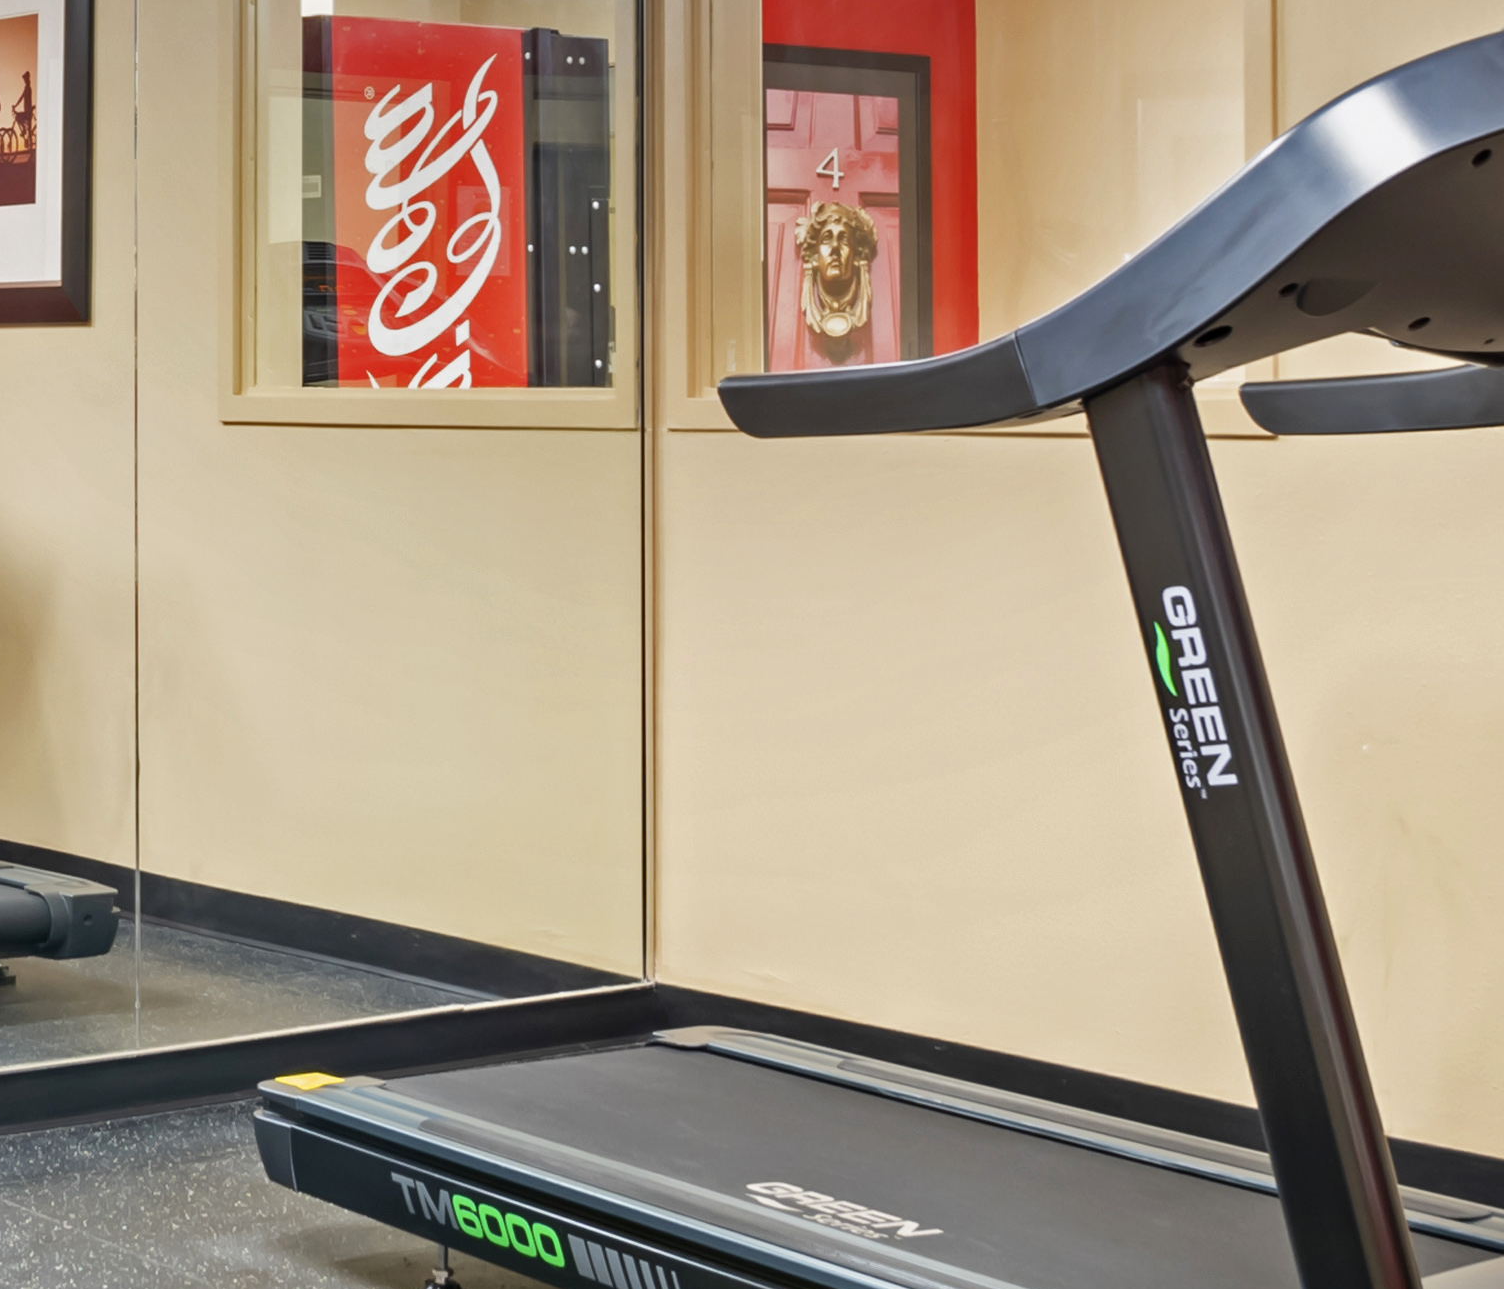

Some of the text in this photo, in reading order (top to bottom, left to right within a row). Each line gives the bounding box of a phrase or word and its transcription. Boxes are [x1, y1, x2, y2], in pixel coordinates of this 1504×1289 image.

[816, 147, 845, 189] 4
[1162, 585, 1238, 786] GREEN
[1169, 707, 1202, 789] Series
[391, 1172, 565, 1268] TM6000
[746, 1181, 944, 1237] GREEN
